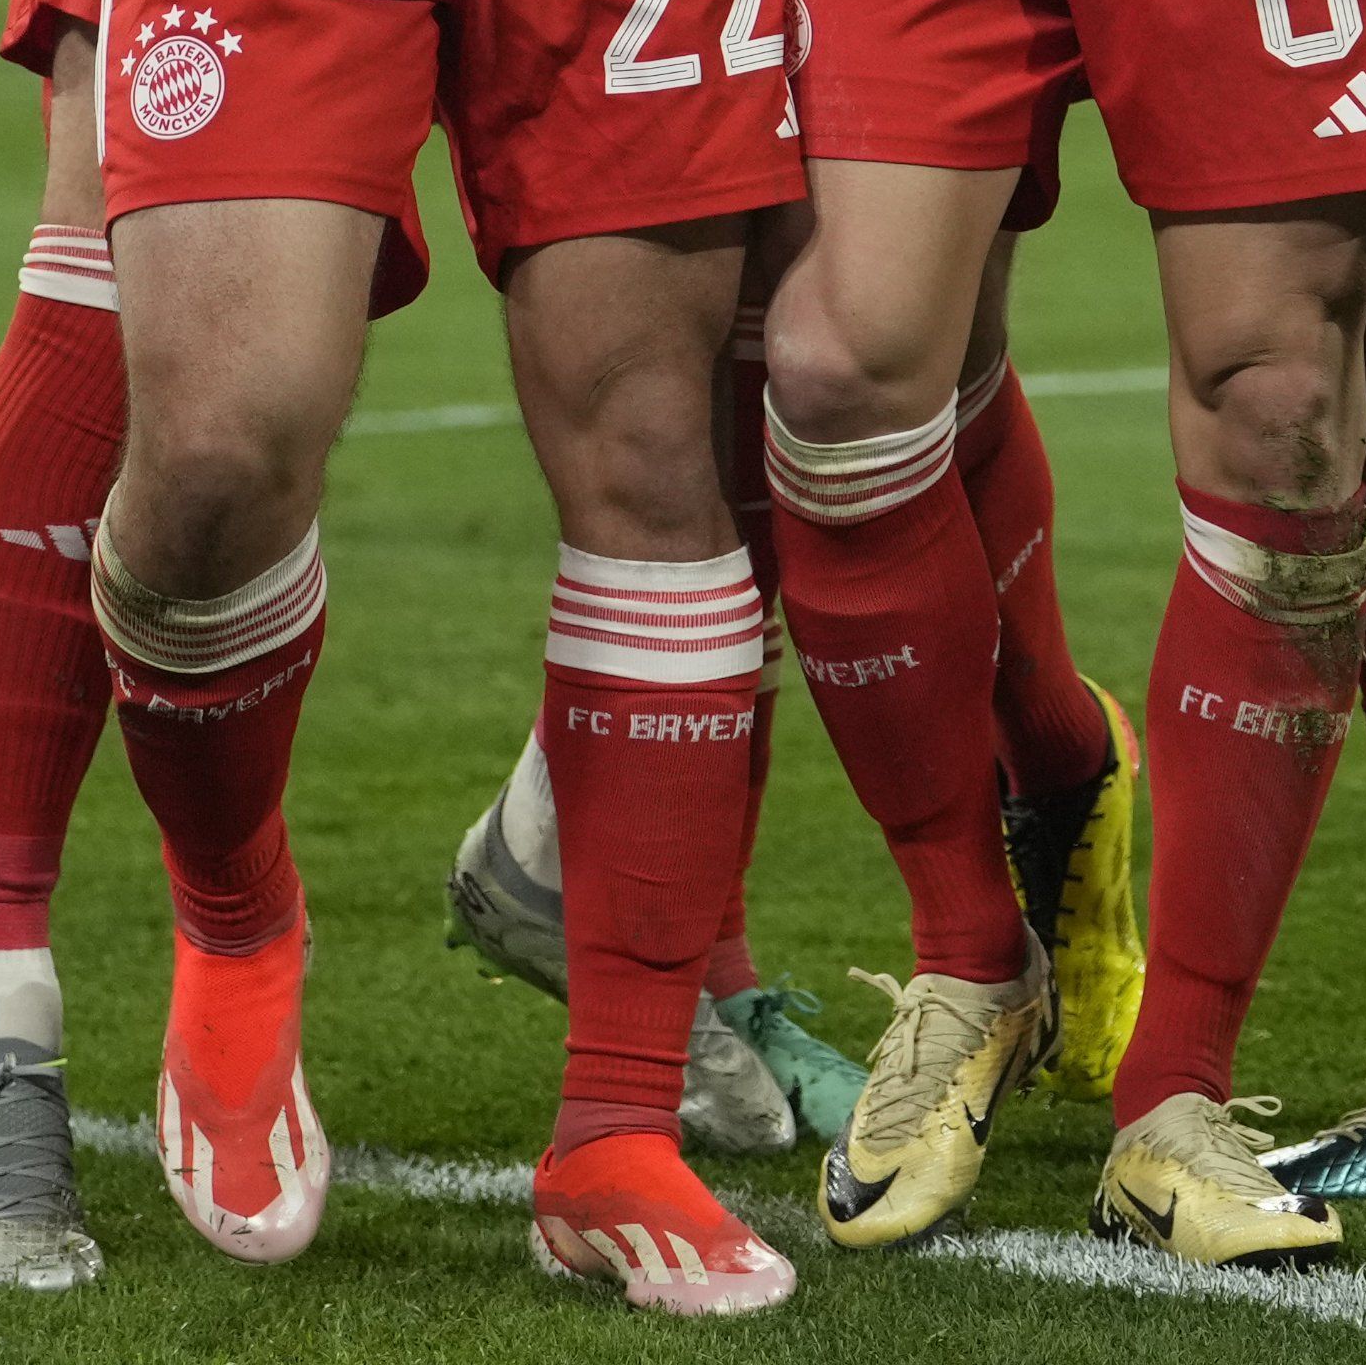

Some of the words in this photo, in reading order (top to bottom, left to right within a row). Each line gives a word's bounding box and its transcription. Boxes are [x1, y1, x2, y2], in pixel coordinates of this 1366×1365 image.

[139, 64, 154, 87] FC
[154, 43, 215, 76] BAYERN
[139, 92, 215, 132] MÜNCHEN
[1178, 684, 1224, 721] FC
[566, 706, 613, 736] FC
[628, 705, 755, 743] BAYER
